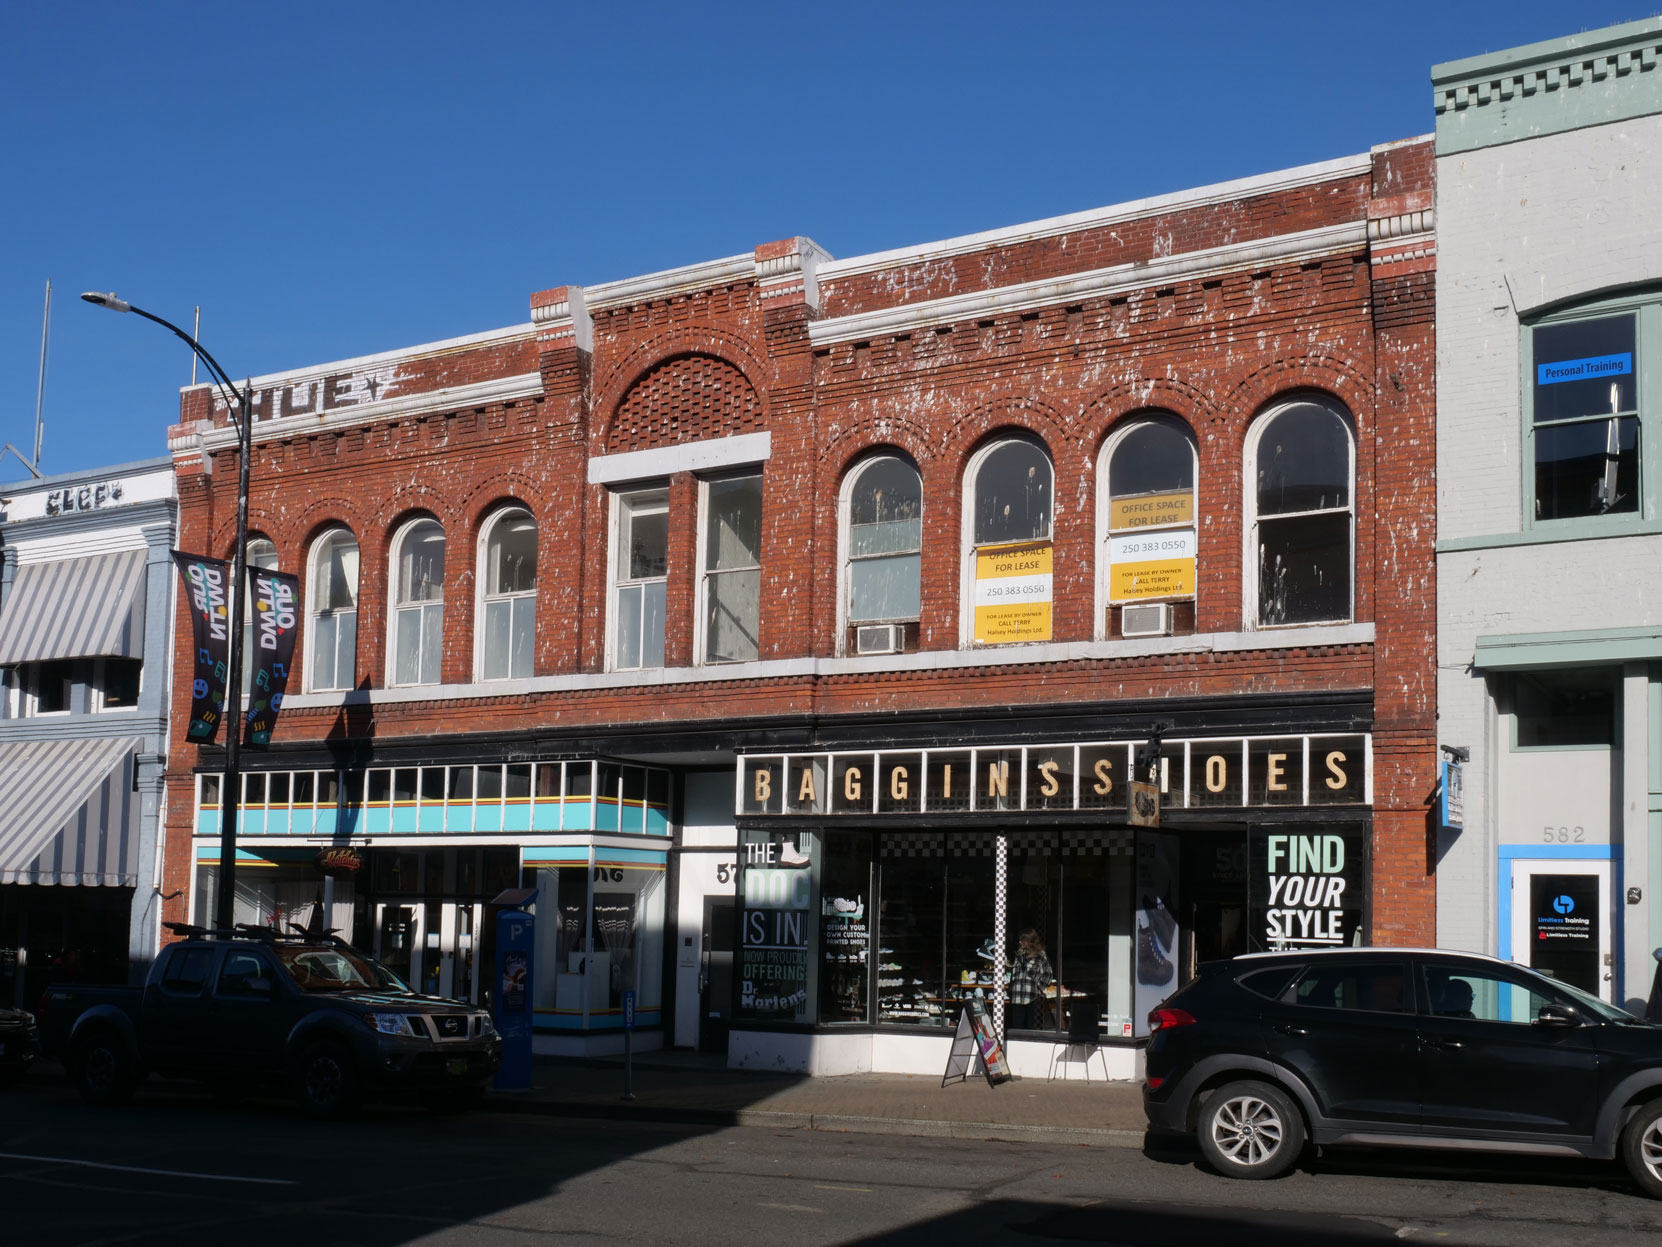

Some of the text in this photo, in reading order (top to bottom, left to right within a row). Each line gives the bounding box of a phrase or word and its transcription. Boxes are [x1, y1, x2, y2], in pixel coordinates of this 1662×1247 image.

[1545, 360, 1624, 378] Personal Training
[1121, 499, 1186, 514] OFFICE SPACE
[1128, 513, 1179, 527] FOR LEASE
[989, 547, 1046, 560] OFFICE SPACE
[1122, 540, 1186, 554] 250 383 0550
[995, 560, 1040, 572] FOR LEASE
[987, 584, 1045, 597] 250 383 0550
[1144, 585, 1172, 594] Holdings
[1015, 618, 1031, 626] TERRY
[987, 629, 1009, 637] Halsey
[1009, 628, 1032, 636] Holdings
[755, 761, 1059, 801] BAGGINS
[1543, 826, 1586, 843] 582
[745, 842, 776, 864] THE
[1267, 835, 1345, 874] FIND
[748, 871, 809, 908] DOC
[1267, 875, 1346, 908] YOUR
[742, 911, 765, 944] IS
[1266, 908, 1344, 939] STYLE
[1564, 917, 1589, 925] Training
[510, 923, 523, 942] P
[744, 951, 808, 964] NOW PROUDLY
[741, 989, 807, 1009] Martens
